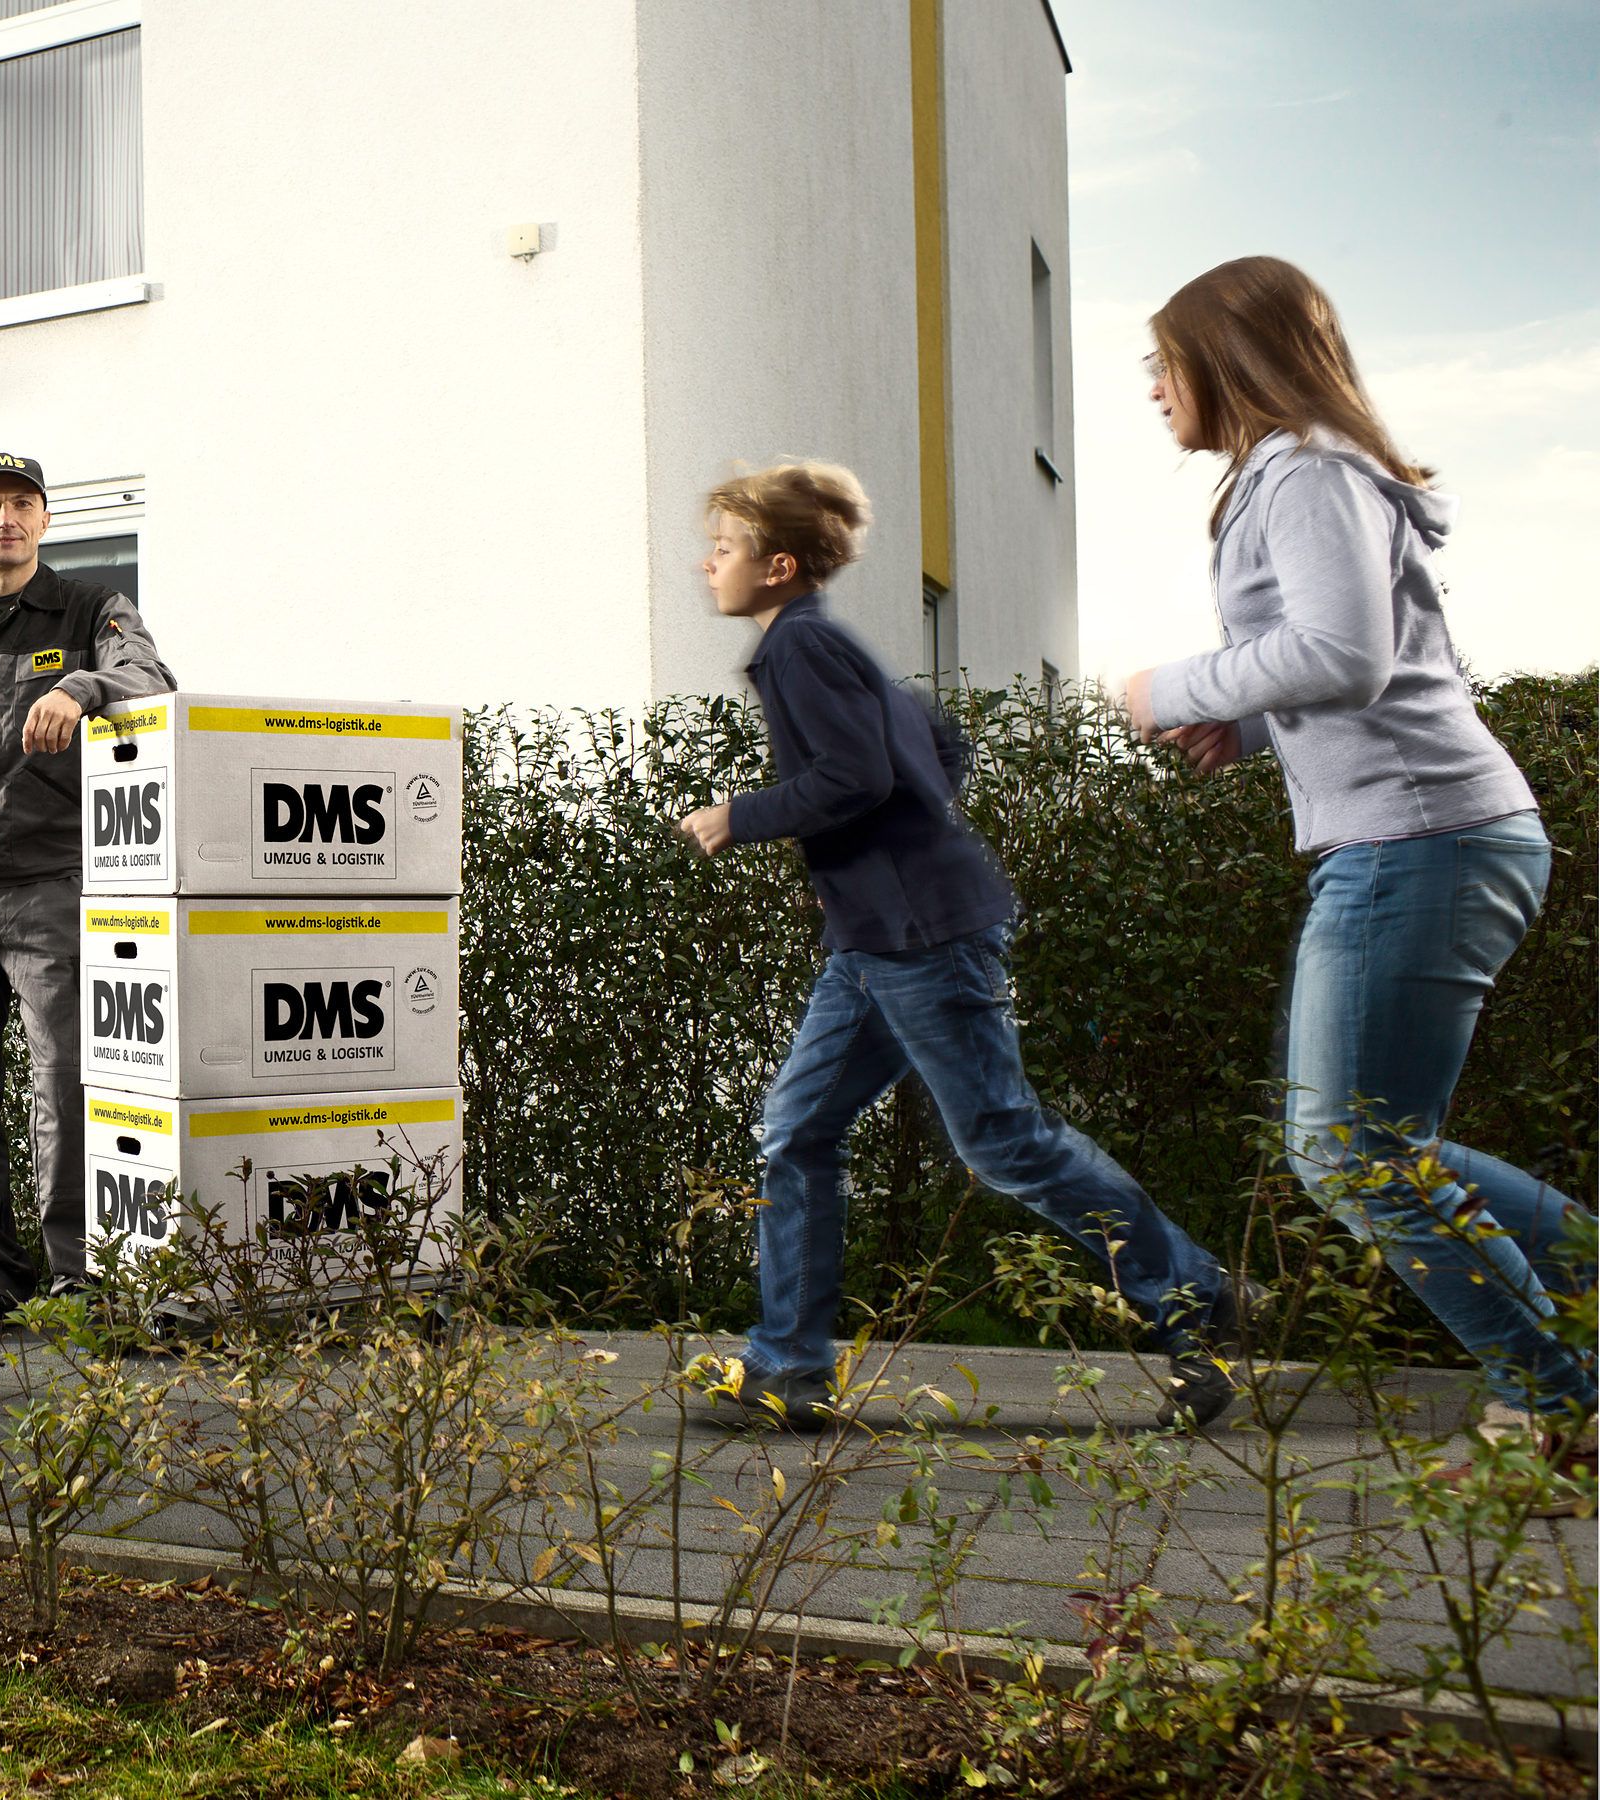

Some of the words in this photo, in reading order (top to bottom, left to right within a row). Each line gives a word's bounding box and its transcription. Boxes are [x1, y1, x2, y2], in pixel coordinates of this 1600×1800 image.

[34, 651, 60, 666] DMS
[92, 714, 157, 735] www.dms-logistik.de
[265, 716, 382, 732] www.dms-logistik.de
[94, 781, 162, 847] DMS
[264, 782, 386, 845] DMS
[94, 854, 120, 868] UMZUG
[122, 854, 128, 867] &
[130, 853, 161, 867] LOGISTIK
[264, 852, 311, 865] UMZUG
[317, 852, 327, 865] &
[332, 852, 385, 866] LOGISTIK
[91, 915, 160, 930] www.dms-logistik.de
[265, 916, 381, 931] www.dms-logistik.de
[93, 979, 165, 1045] DMS
[264, 979, 385, 1041] DMS
[93, 1046, 121, 1061] UMZUG
[123, 1049, 129, 1062] &
[132, 1050, 164, 1066] LOGISTIK
[264, 1049, 311, 1063] UMZUG
[317, 1048, 327, 1061] &
[332, 1046, 384, 1060] LOGISTIK
[93, 1106, 163, 1128] www.dms-logistik.de
[268, 1108, 388, 1127] www.dms-logistik.de
[96, 1169, 168, 1240] DMS
